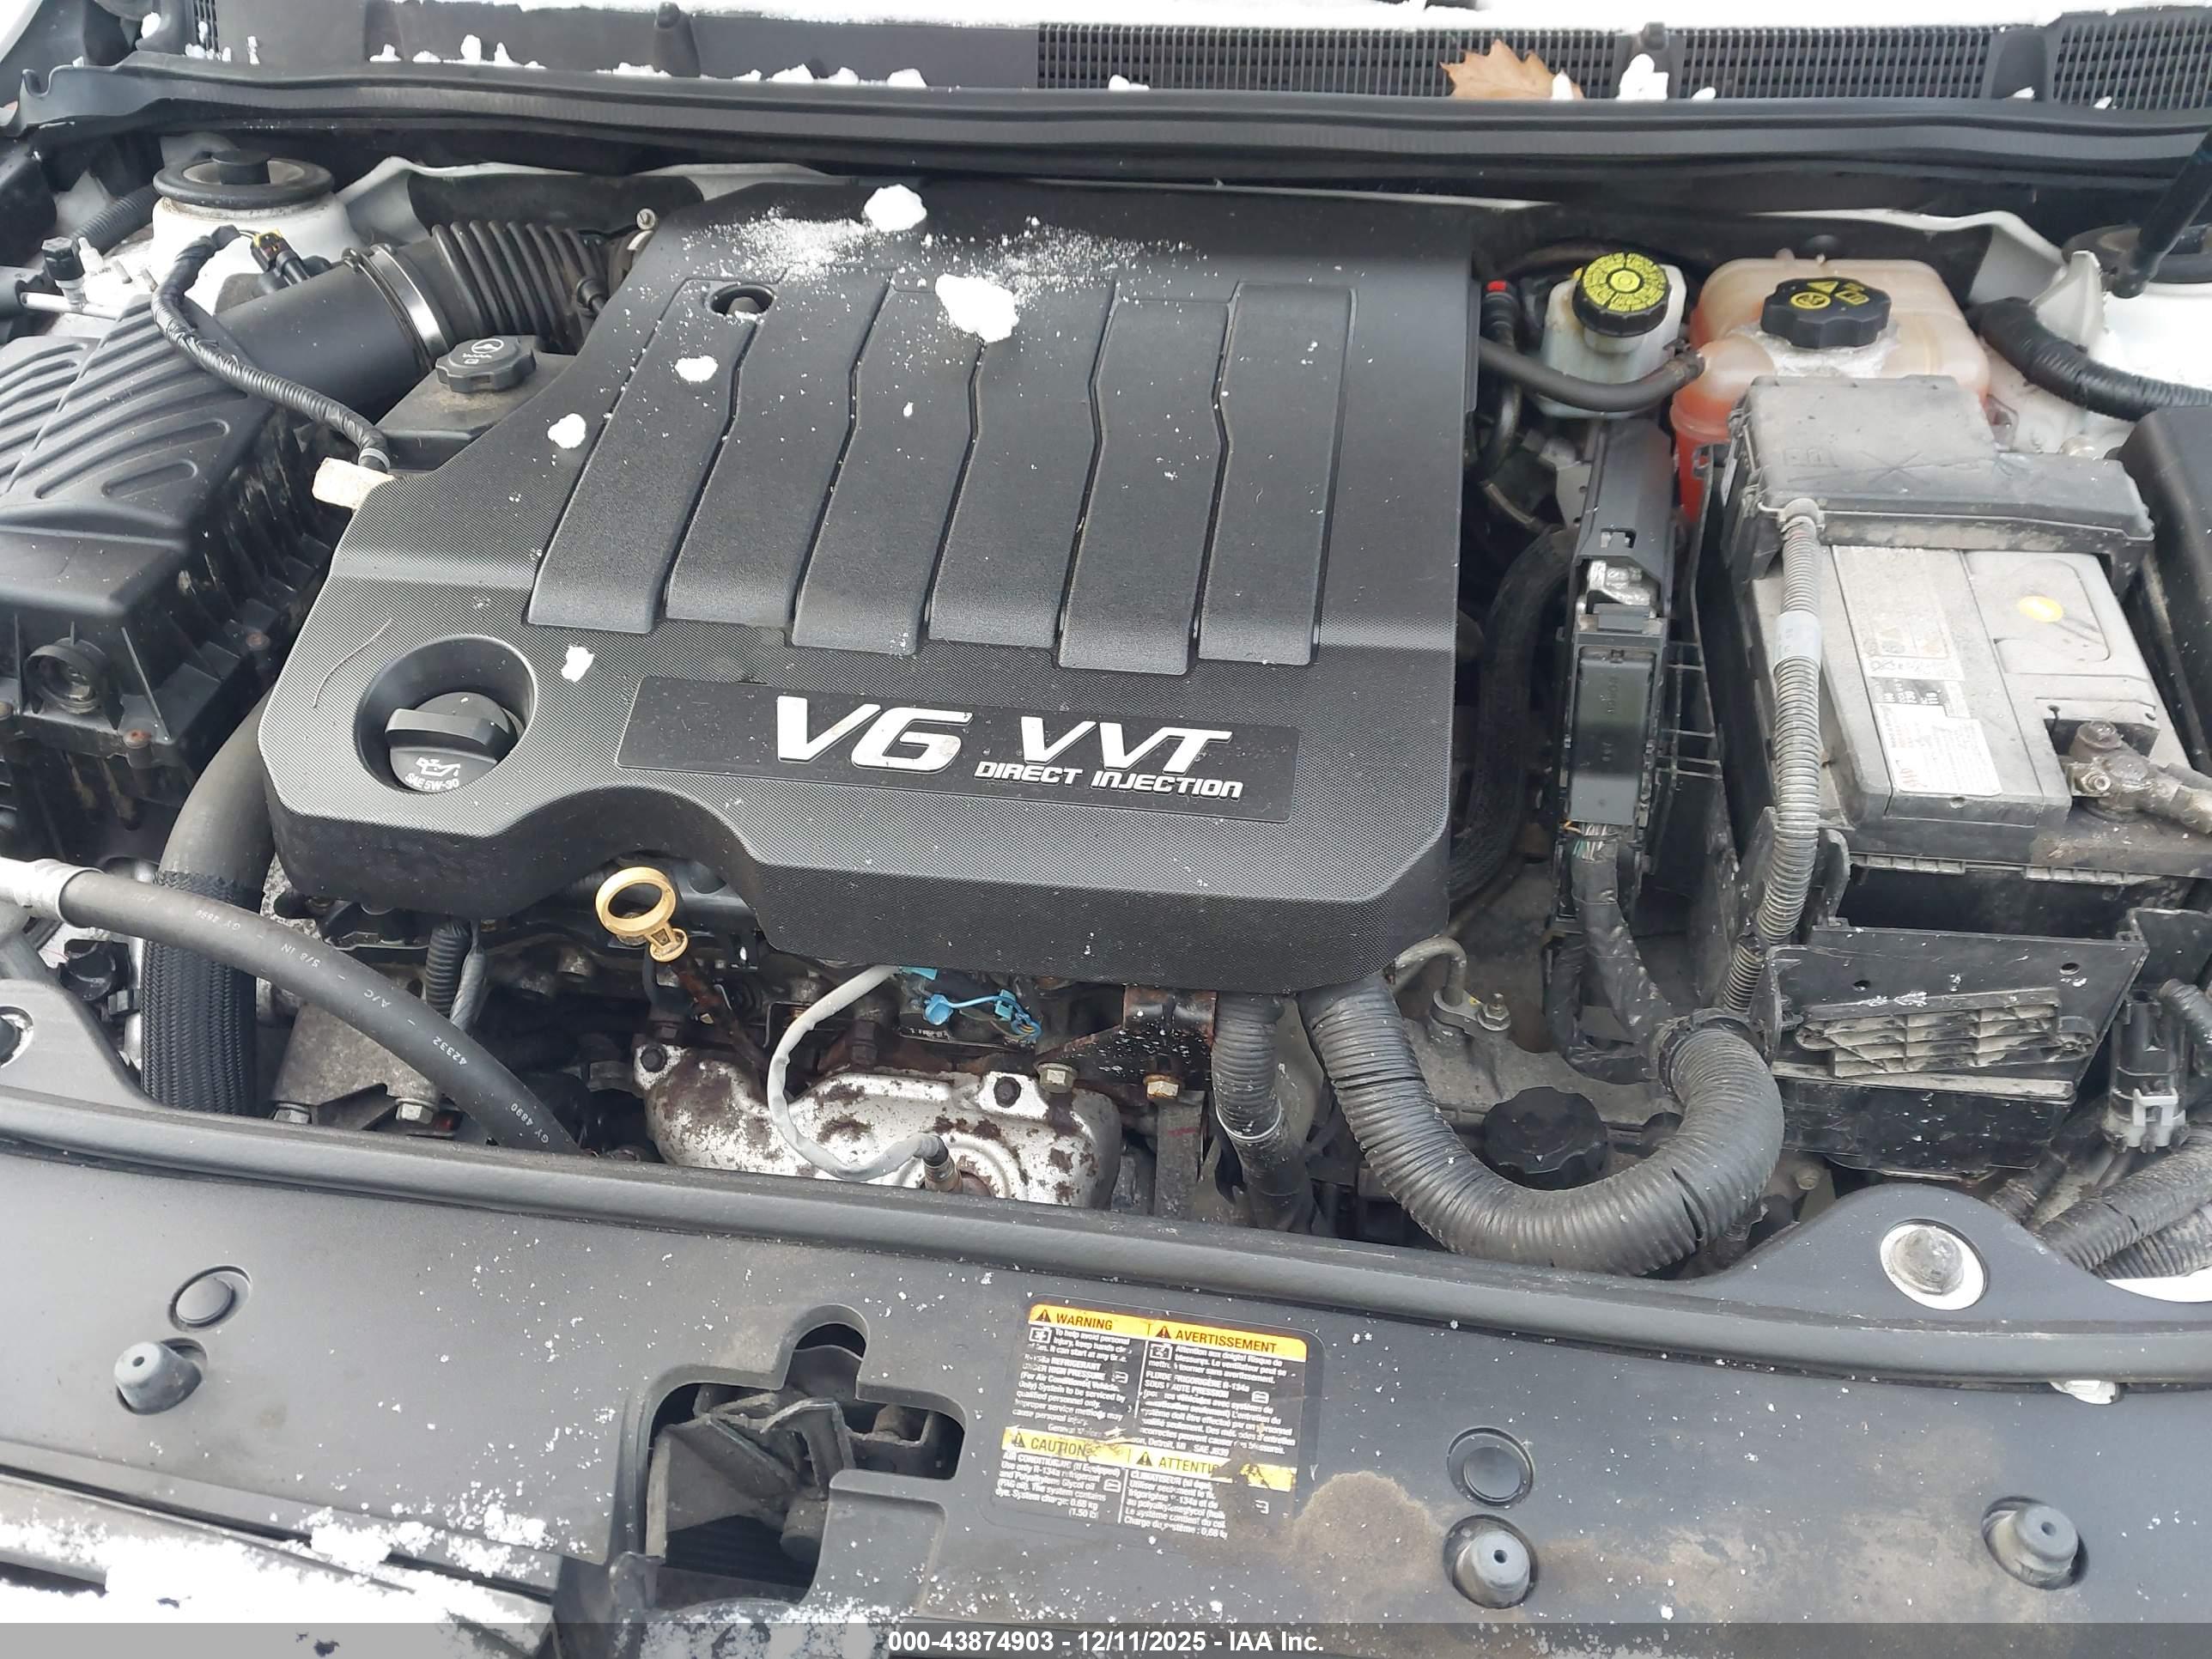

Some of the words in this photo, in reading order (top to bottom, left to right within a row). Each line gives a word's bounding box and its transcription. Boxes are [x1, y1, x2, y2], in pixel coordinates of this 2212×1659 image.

[777, 696, 973, 772] V6
[1021, 716, 1232, 773] VVT
[405, 773, 425, 787] SAE
[424, 778, 459, 790] 5W-30
[975, 762, 1083, 785] DIRECT
[1091, 770, 1243, 799] INJECTION
[281, 944, 295, 955] IN
[363, 988, 392, 1008] A/C
[432, 1036, 468, 1066] 42332
[510, 1103, 533, 1127] 4890
[534, 1128, 550, 1144] GY
[1055, 1313, 1113, 1330] WARNING
[1064, 1330, 1079, 1339] help
[1079, 1332, 1099, 1341] avoid
[1100, 1334, 1130, 1345] personal
[1176, 1329, 1277, 1352] AVERTISSEMENT
[1070, 1347, 1087, 1357] start
[1075, 1340, 1092, 1349] keep
[1093, 1342, 1114, 1352] hands
[1175, 1346, 1207, 1357] Attention
[1272, 1358, 1283, 1367] de
[1144, 1379, 1164, 1389] SOUS
[1037, 1383, 1065, 1395] System
[1065, 1387, 1073, 1395] to
[1085, 1389, 1115, 1401] serviced
[1115, 1394, 1126, 1402] by
[1084, 1399, 1100, 1408] only.
[1030, 1437, 1085, 1455] CAUTION
[1016, 1462, 1032, 1473] only
[1033, 1465, 1060, 1476] R-134a
[1046, 1485, 1073, 1497] system
[1061, 1478, 1084, 1489] Glycol
[1085, 1481, 1095, 1490] oil
[1011, 1490, 1040, 1502] System
